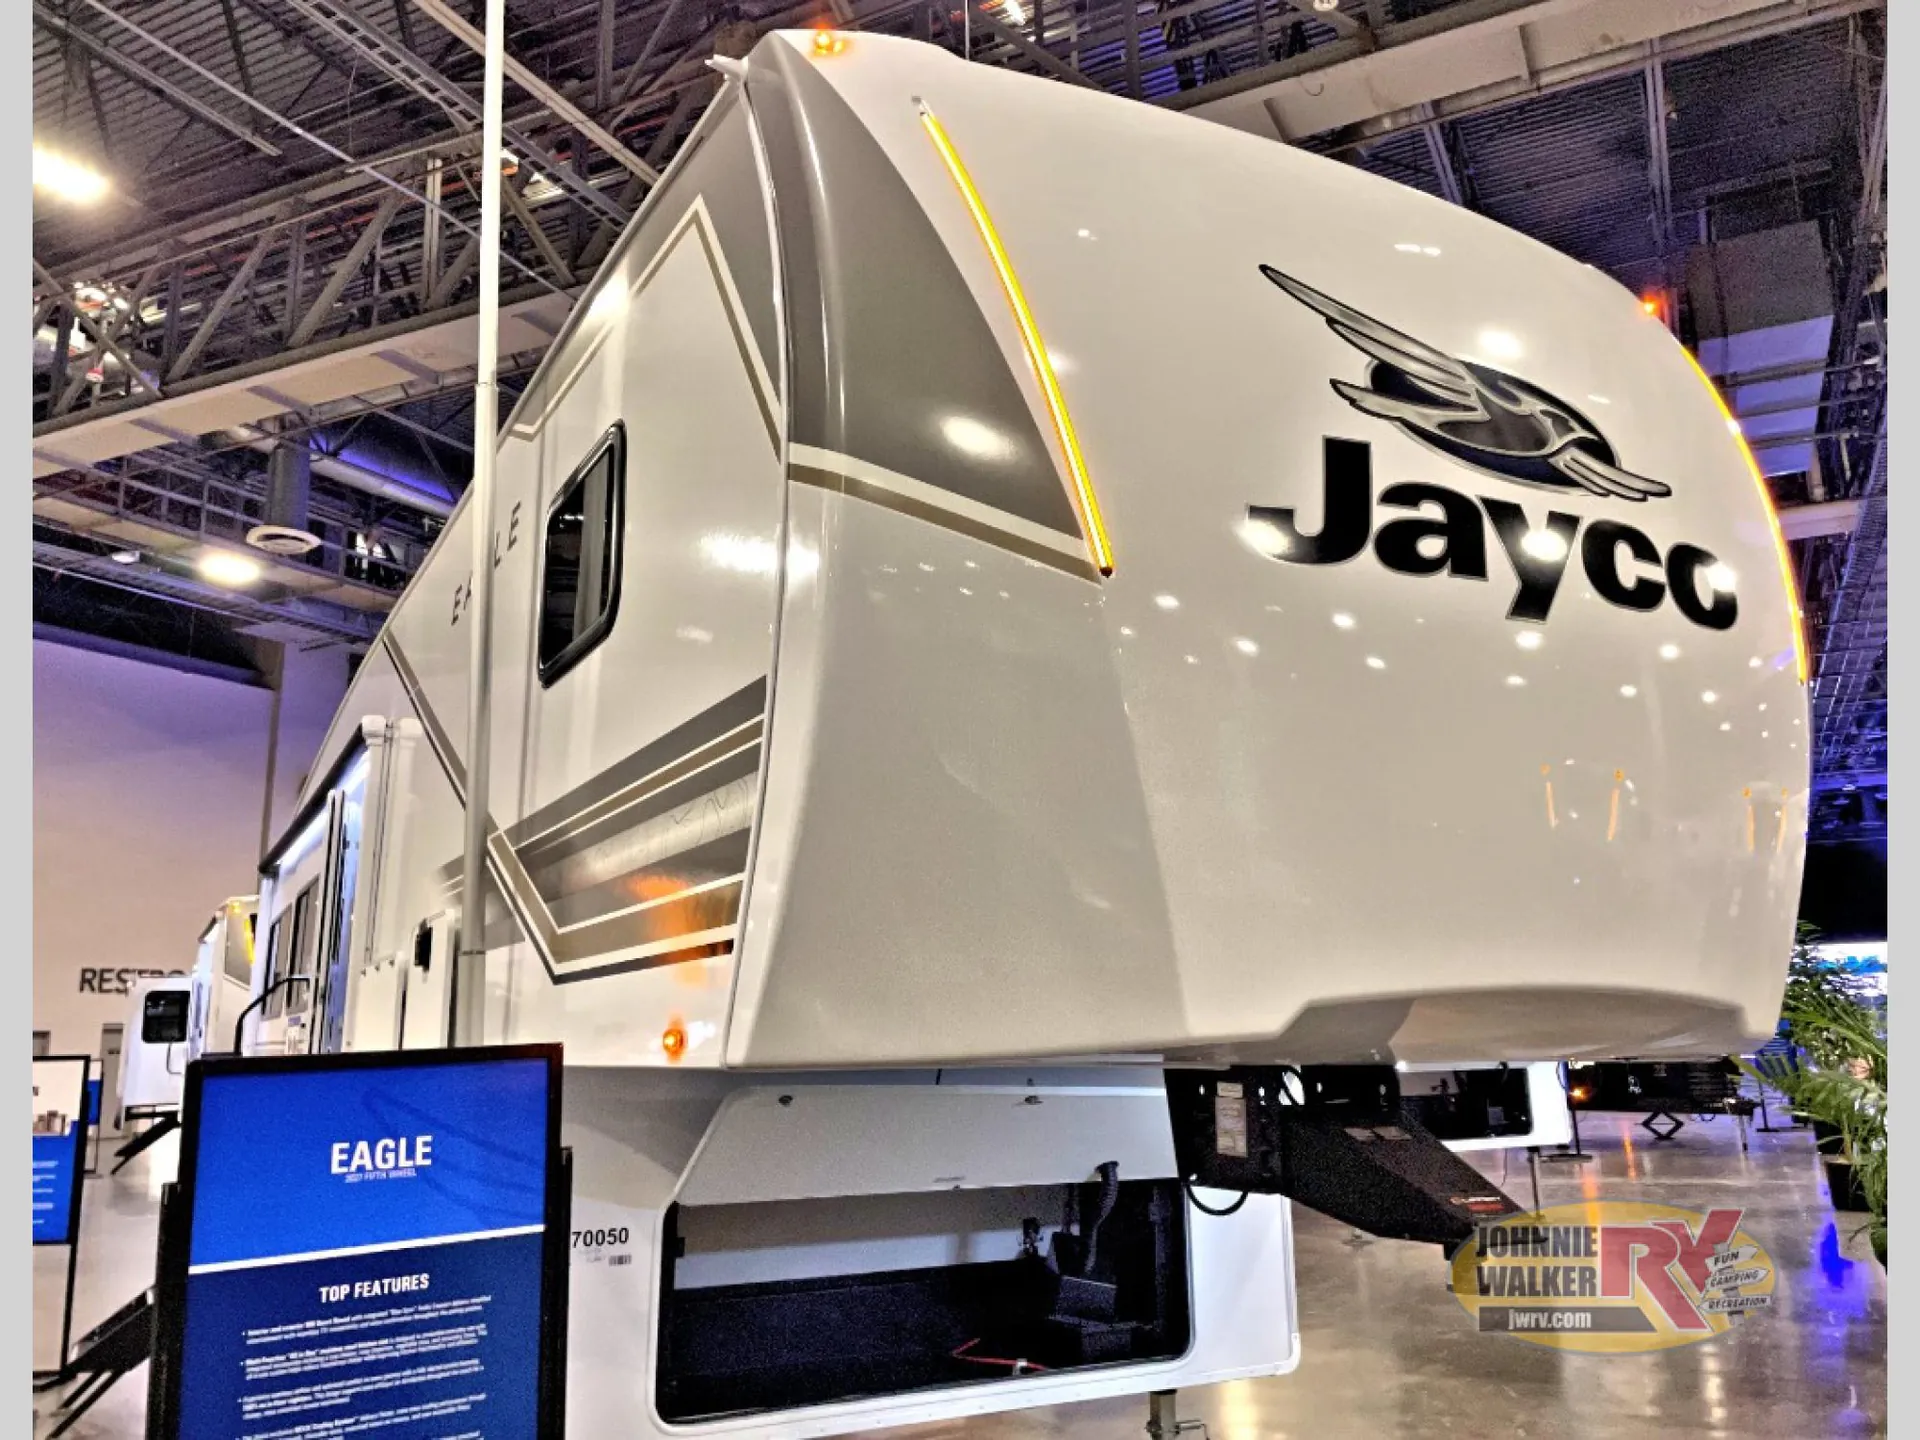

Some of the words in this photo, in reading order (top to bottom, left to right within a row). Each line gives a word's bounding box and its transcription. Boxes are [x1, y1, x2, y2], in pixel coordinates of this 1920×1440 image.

[1244, 434, 1739, 632] Jayco
[330, 1135, 433, 1175] EAGLE
[319, 1283, 350, 1304] TOP
[353, 1272, 430, 1299] FEATURES
